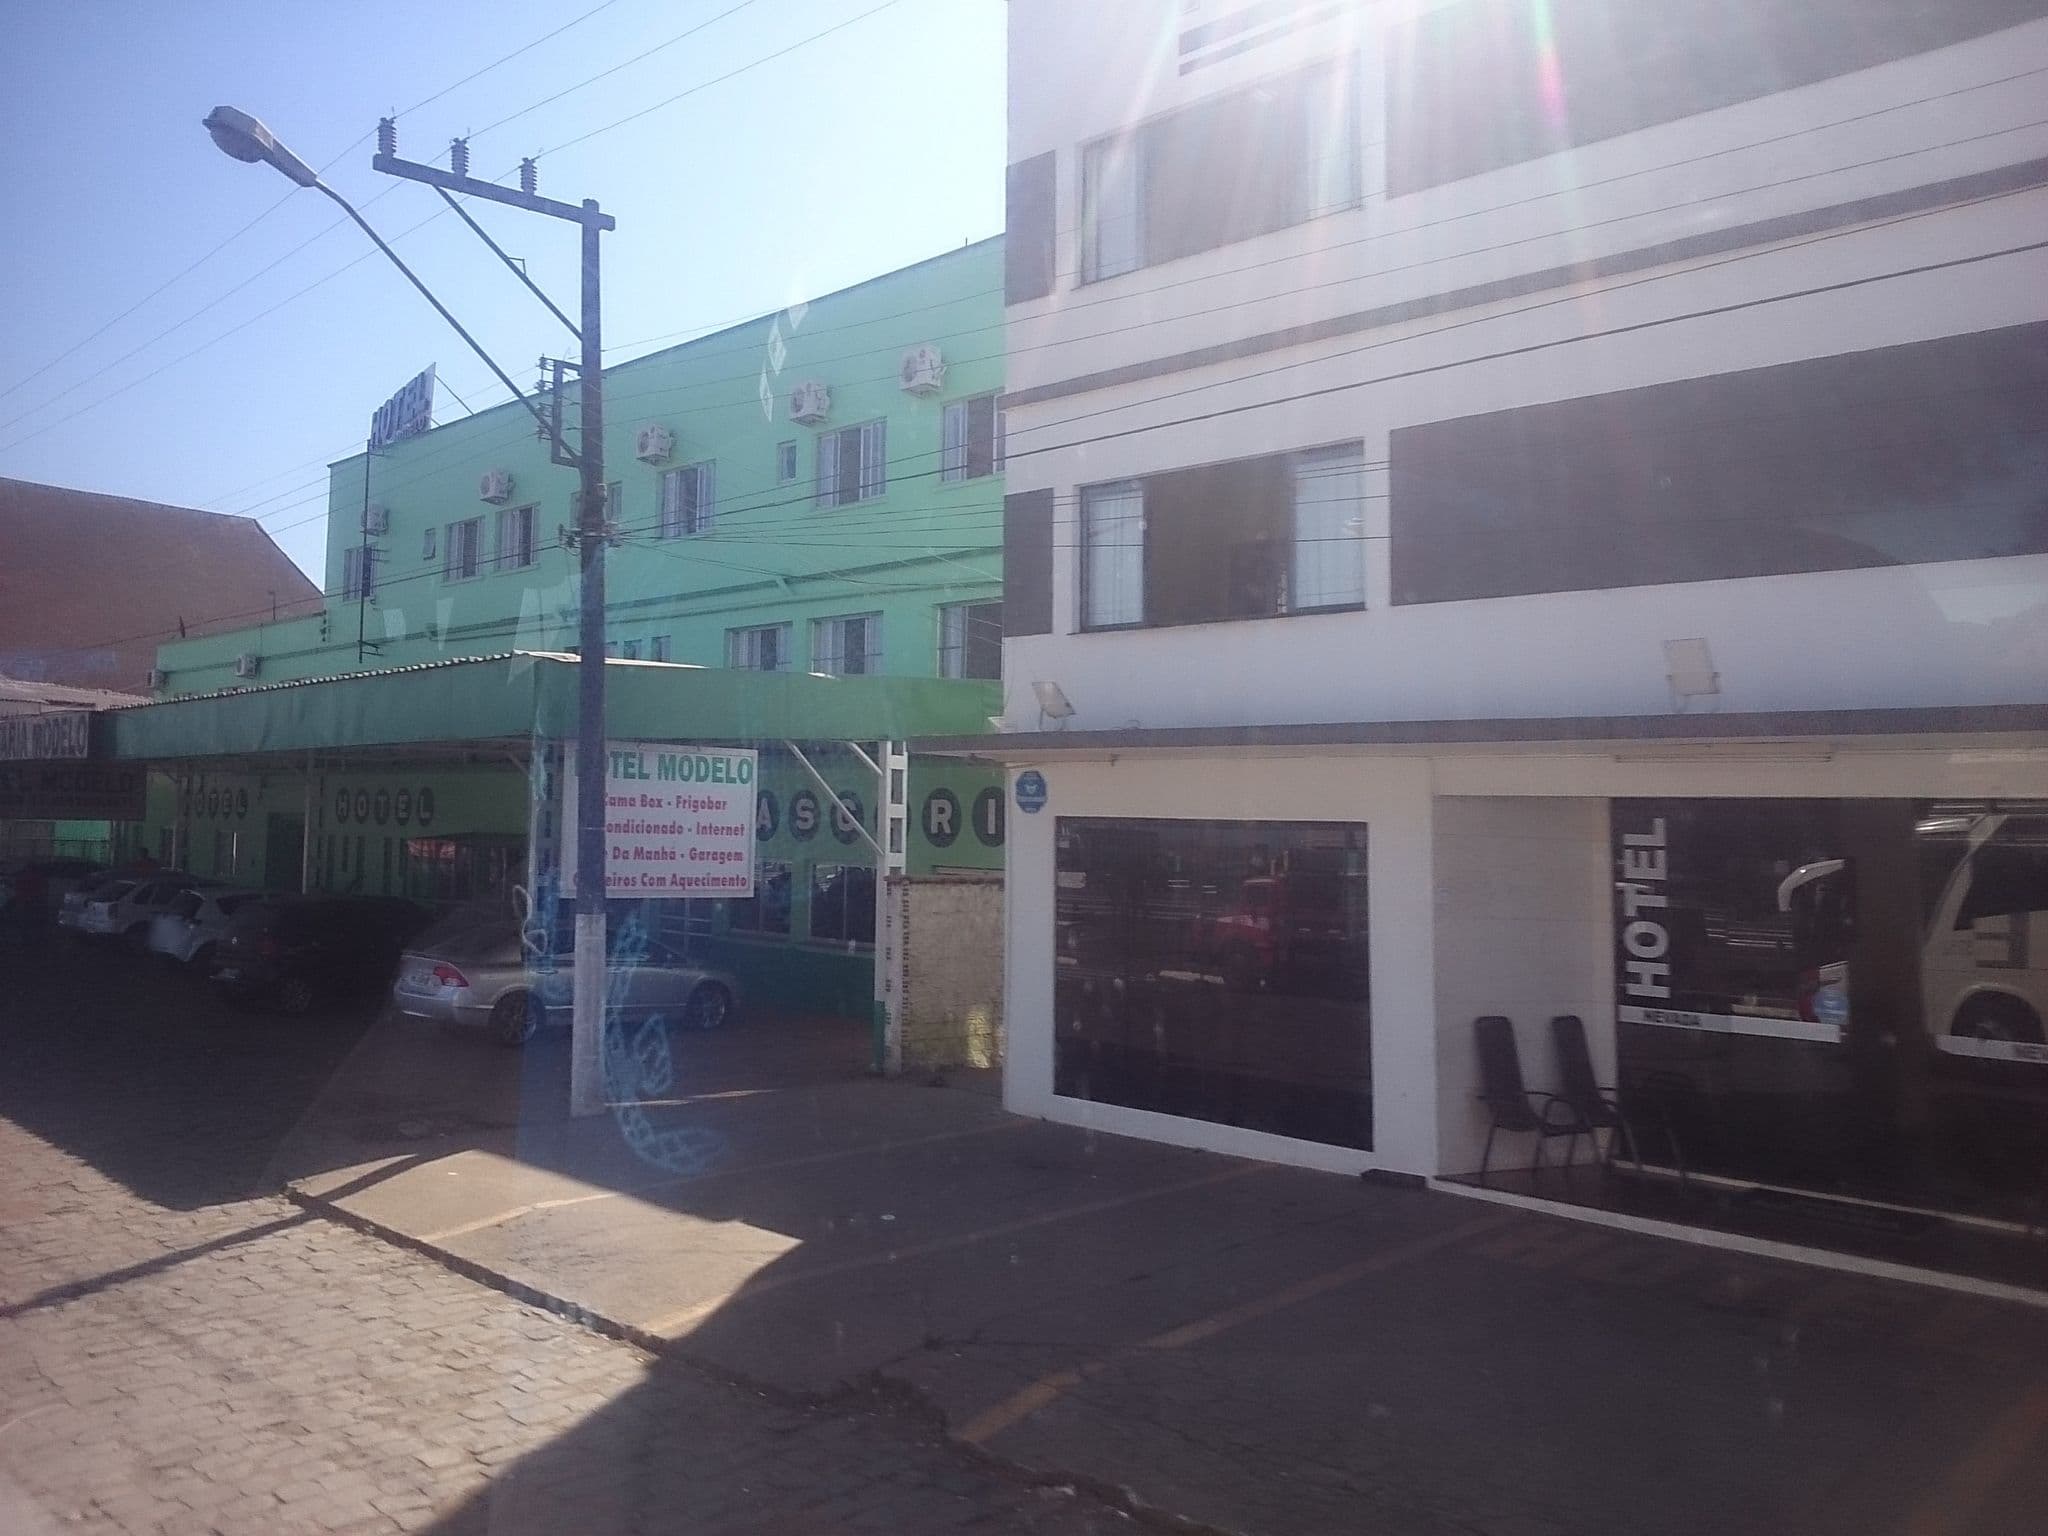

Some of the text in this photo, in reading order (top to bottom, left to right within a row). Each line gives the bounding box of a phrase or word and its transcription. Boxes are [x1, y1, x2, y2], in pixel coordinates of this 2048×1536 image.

[371, 371, 430, 443] HOTEL
[606, 751, 753, 785] TEL MODELO
[338, 790, 433, 822] HOTEL
[640, 794, 663, 808] Box
[675, 795, 728, 813] Frigobar
[606, 819, 745, 837] ondicionado Internet
[613, 846, 629, 860] Da
[689, 847, 744, 865] Garagem
[640, 873, 667, 887] Com
[671, 873, 747, 890] Aquecimento
[1623, 817, 1670, 998] HOTEL
